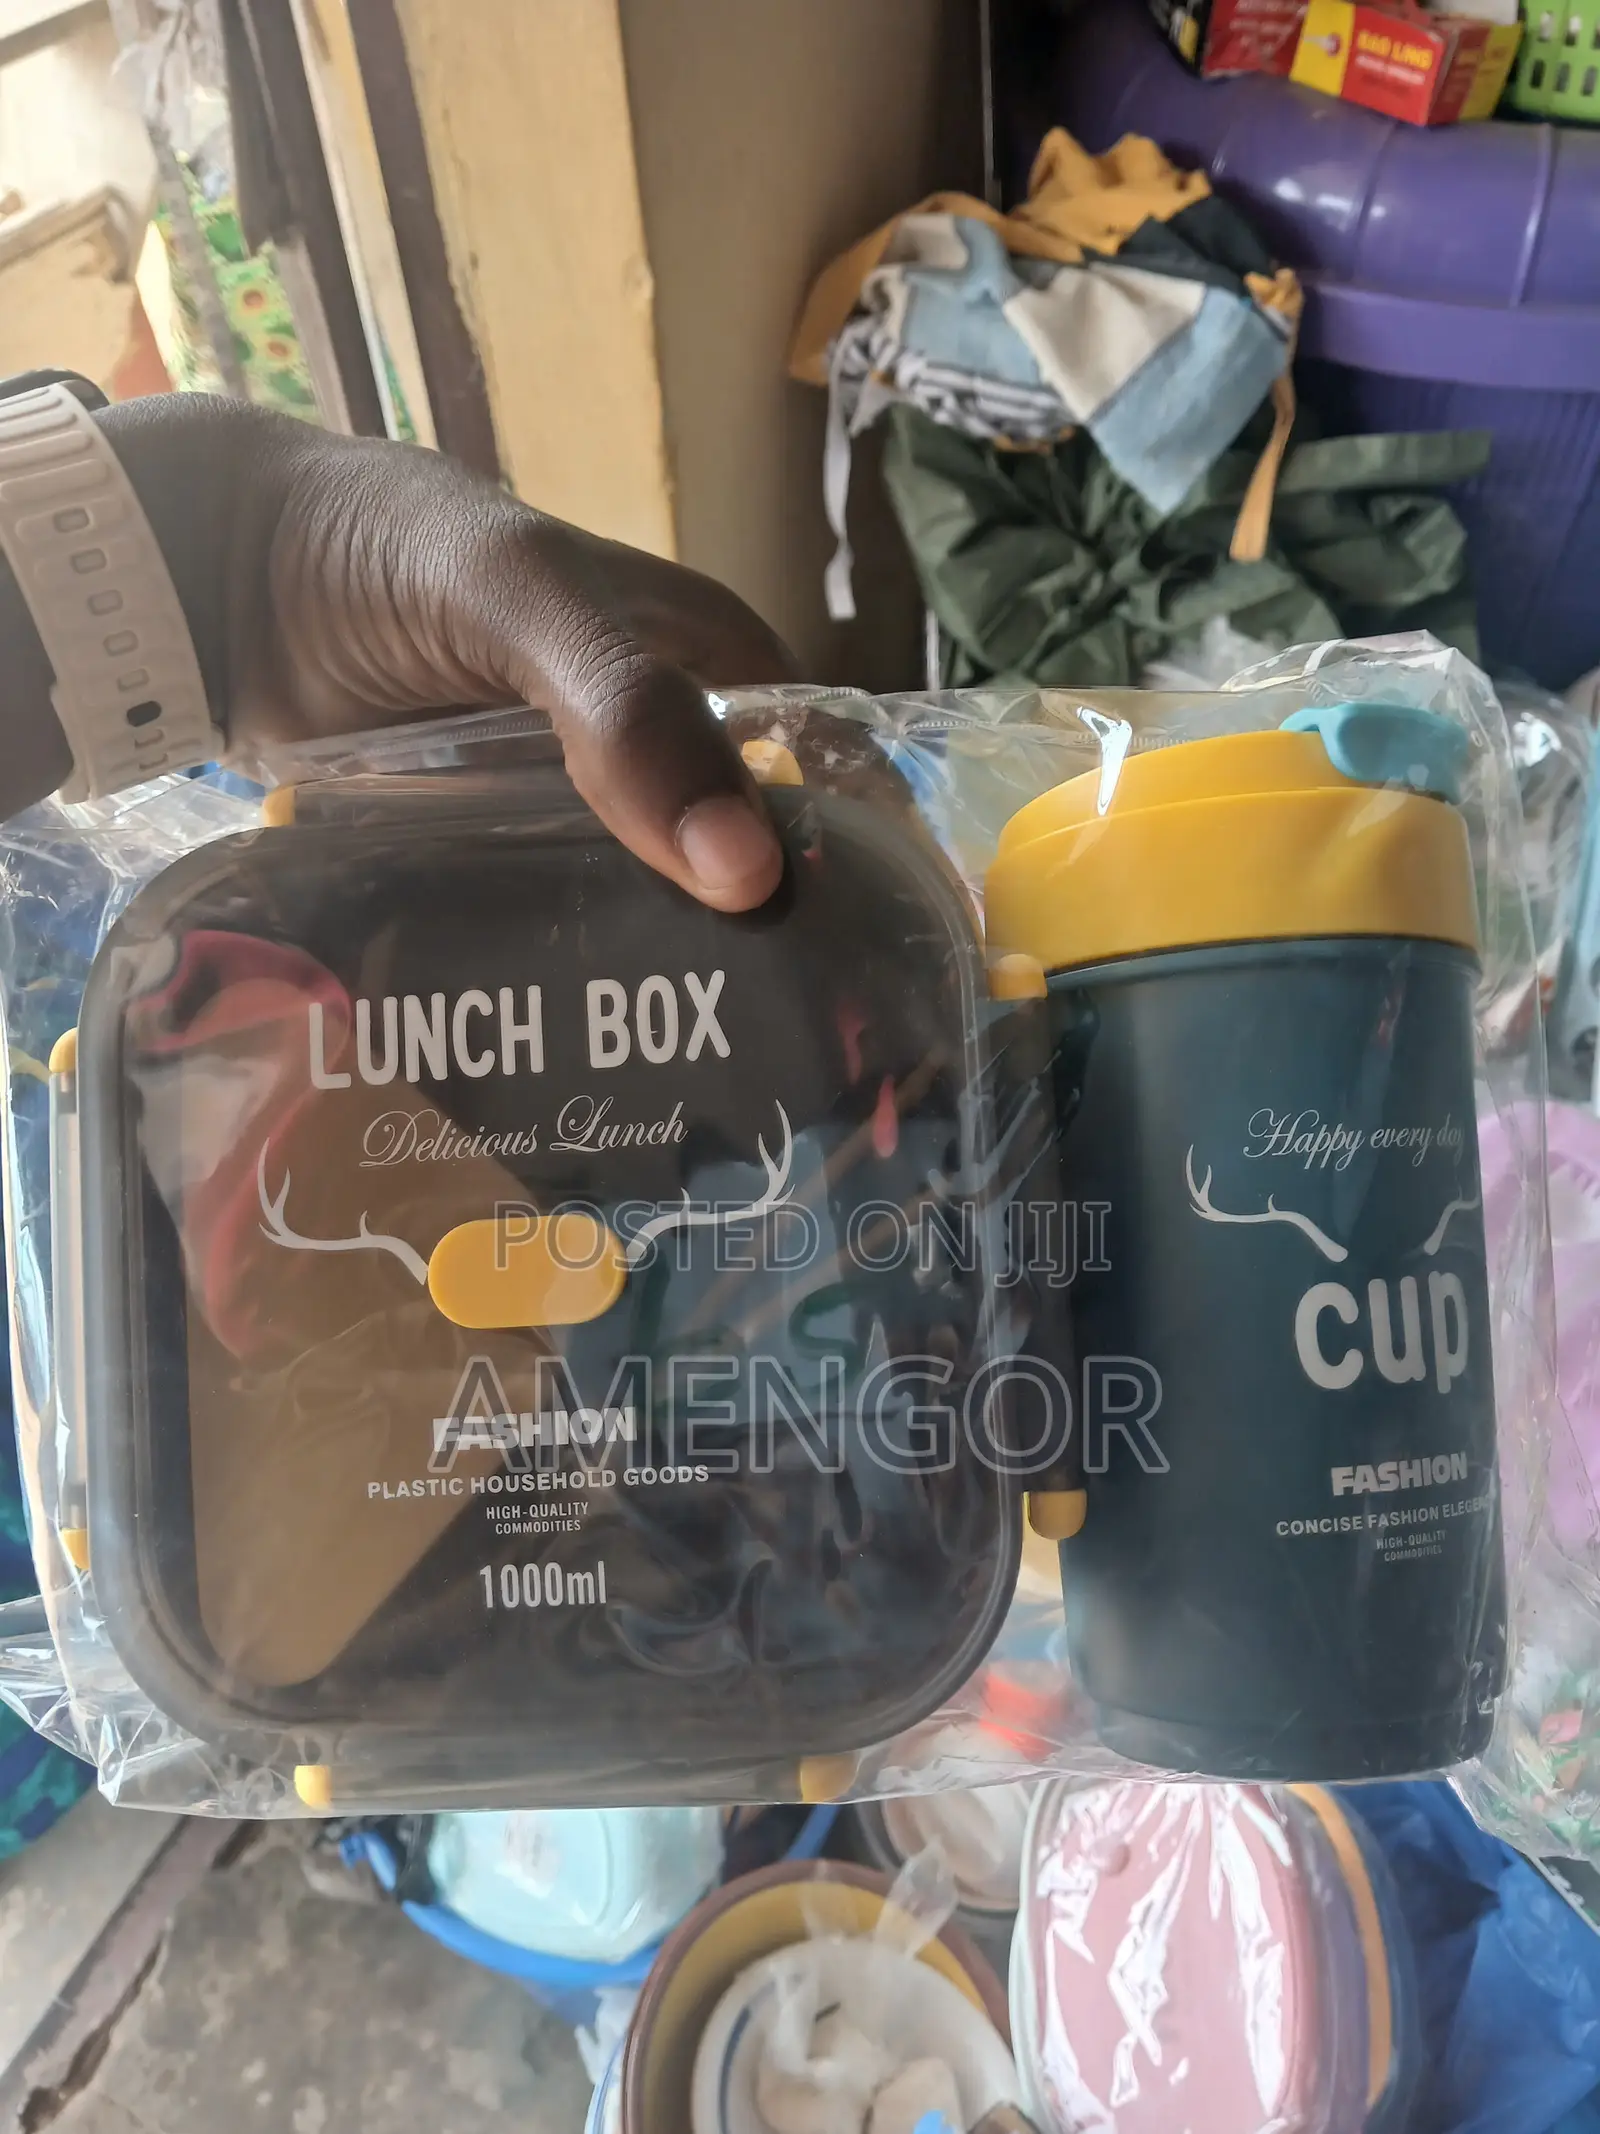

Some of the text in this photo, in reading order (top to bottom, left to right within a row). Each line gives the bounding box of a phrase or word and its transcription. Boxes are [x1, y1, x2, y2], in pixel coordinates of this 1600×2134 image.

[308, 969, 732, 1090] LUNCH BOX
[359, 1095, 688, 1168] Delicious Lunch
[1243, 1108, 1365, 1171] Happy
[1370, 1127, 1434, 1167] every
[1294, 1271, 1470, 1394] cup
[432, 1406, 637, 1452] FASHION
[367, 1464, 709, 1499] PLASTIC HOUSEHOLD GOODS
[1330, 1451, 1469, 1496] FASHION
[485, 1501, 589, 1520] HIGH-QUALITY
[494, 1520, 582, 1535] COMMODITIES
[1276, 1515, 1364, 1536] CONCISE
[1366, 1504, 1440, 1529] FASHION
[1375, 1530, 1448, 1550] HIGH-QUALITY
[1383, 1546, 1443, 1563] COMMODITIES
[478, 1561, 607, 1609] 1000ml
